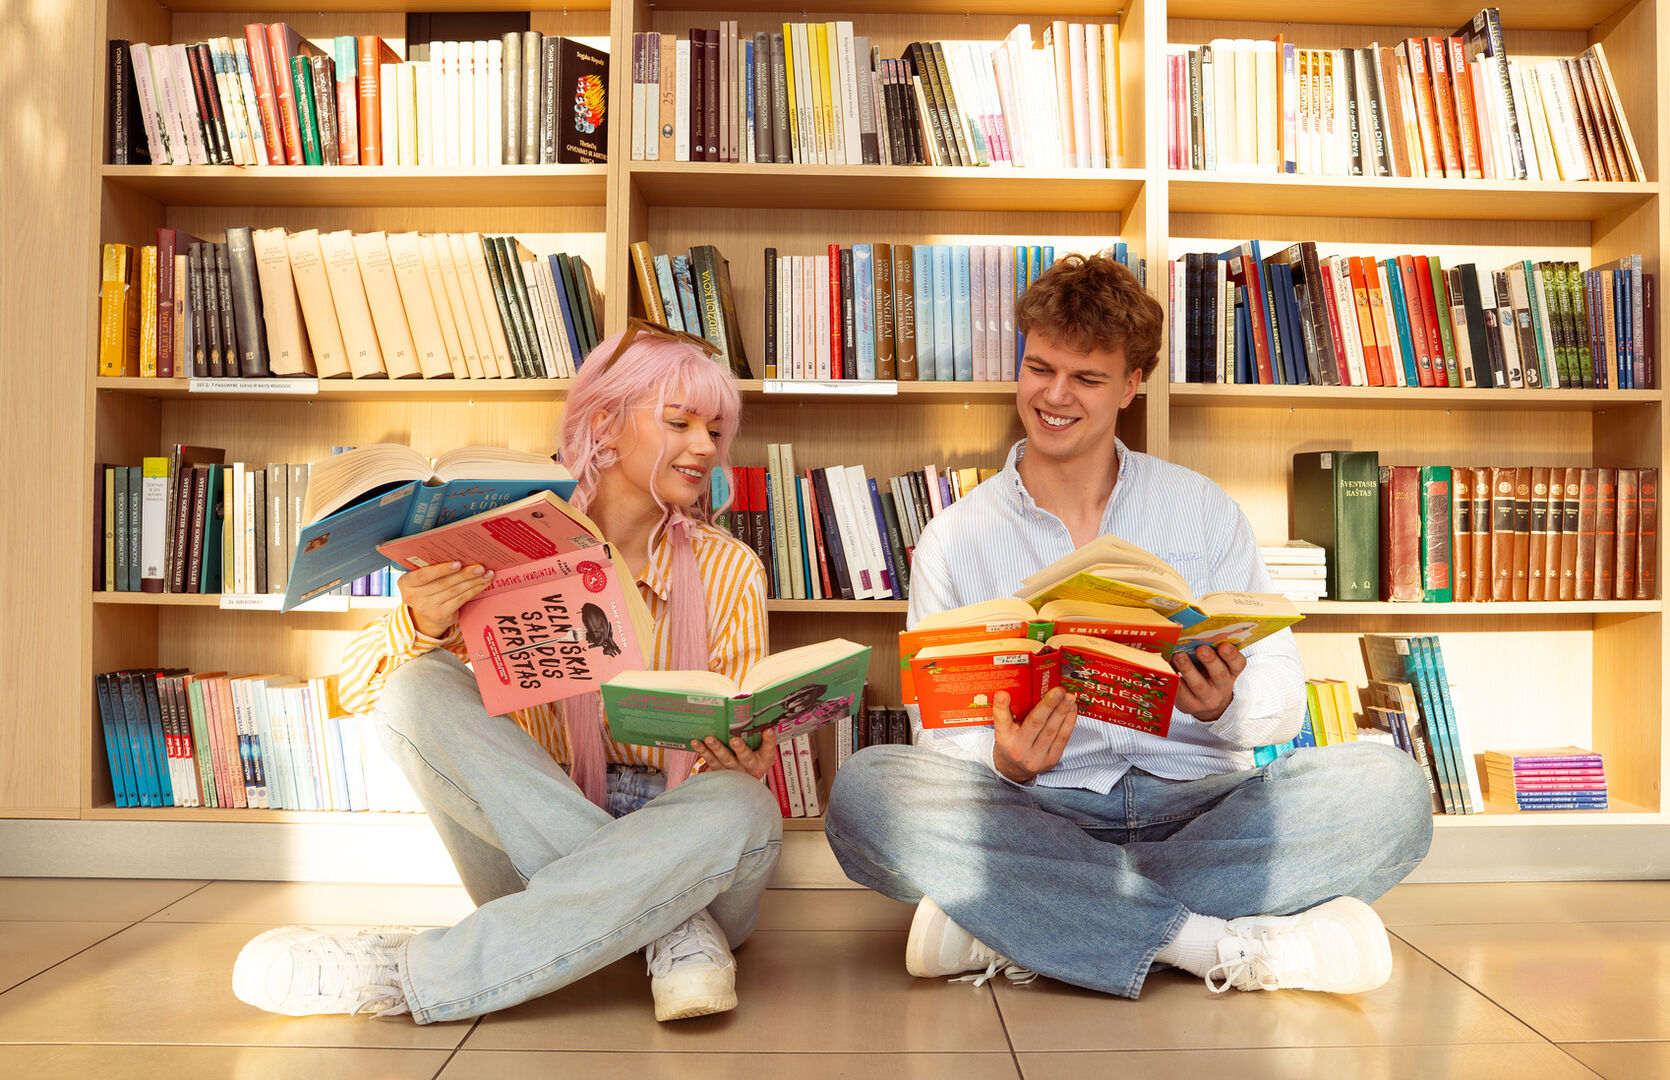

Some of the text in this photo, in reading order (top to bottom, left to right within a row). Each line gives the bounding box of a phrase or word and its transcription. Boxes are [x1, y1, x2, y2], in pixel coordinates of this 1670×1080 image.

[1413, 42, 1425, 73] KROSNEY
[1433, 42, 1445, 73] KROSNEY
[1454, 42, 1465, 73] KROSNEY
[662, 92, 674, 105] 25
[931, 107, 941, 128] SCHMITT
[940, 107, 950, 128] SCHMITT
[702, 269, 719, 337] DIDŽIOJI KOVA
[884, 292, 892, 338] ANGELAI
[905, 293, 914, 339] ANGELAI
[1268, 290, 1278, 328] TESTAMENTAS
[161, 311, 169, 334] LAMA
[1340, 480, 1377, 488] ŠVENTASIS
[1346, 488, 1372, 497] RAŠTAS
[118, 491, 126, 525] TEOLOGIJA
[132, 491, 140, 525] TEOLOGIJA
[180, 498, 188, 528] RELIGIJOS
[195, 498, 203, 528] RELIGIJOS
[736, 513, 744, 526] Kur
[755, 514, 763, 526] Kur
[177, 528, 186, 558] SENOSIOS
[193, 528, 201, 558] SENOSIOS
[756, 529, 766, 547] Dievas
[175, 558, 184, 586] LIETUVIŲ
[190, 558, 199, 585] LIETUVIŲ
[1350, 581, 1358, 589] A
[541, 593, 593, 682] VELNIŠKAI
[609, 600, 629, 649] JANE FALLON
[1069, 627, 1158, 638] EMILY HENRY
[494, 614, 542, 690] KERŠTAS
[521, 610, 564, 680] SALDUS
[776, 692, 855, 735] EGGY
[1107, 718, 1153, 734] HOGAN
